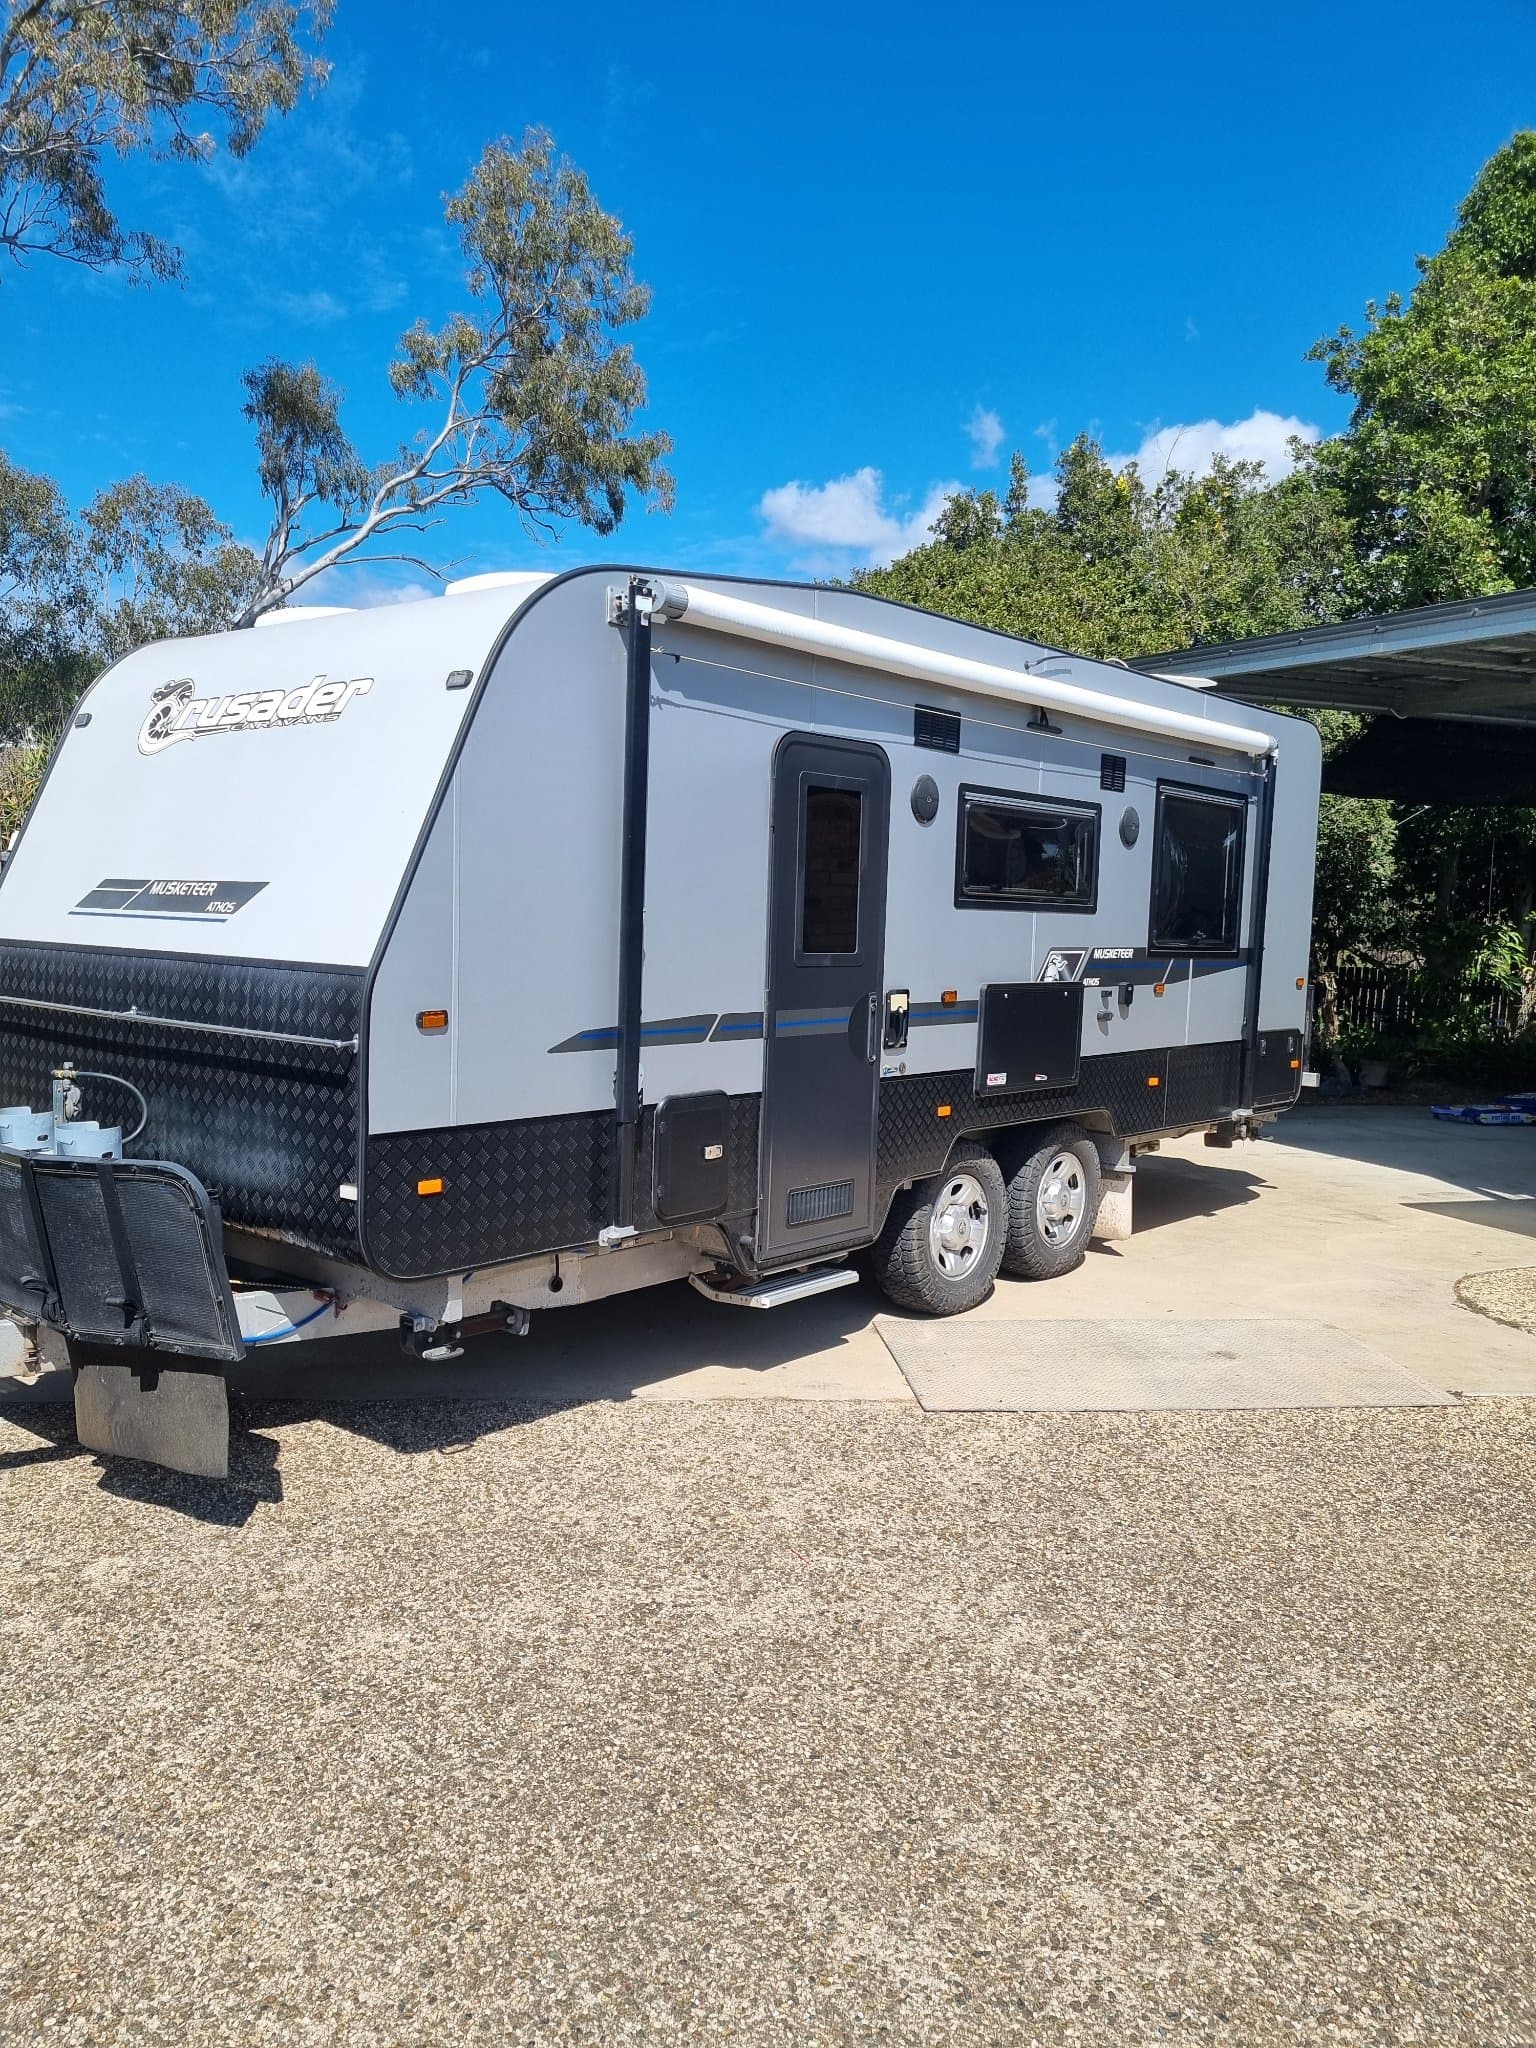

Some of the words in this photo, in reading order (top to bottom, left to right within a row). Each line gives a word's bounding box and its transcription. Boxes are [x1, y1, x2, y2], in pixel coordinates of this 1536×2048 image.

[138, 675, 374, 756] Crusader
[229, 713, 341, 732] CARAVANS
[149, 881, 218, 896] MUSKETEER
[205, 901, 237, 912] ATHOS
[1093, 948, 1134, 959] MUSKETEER
